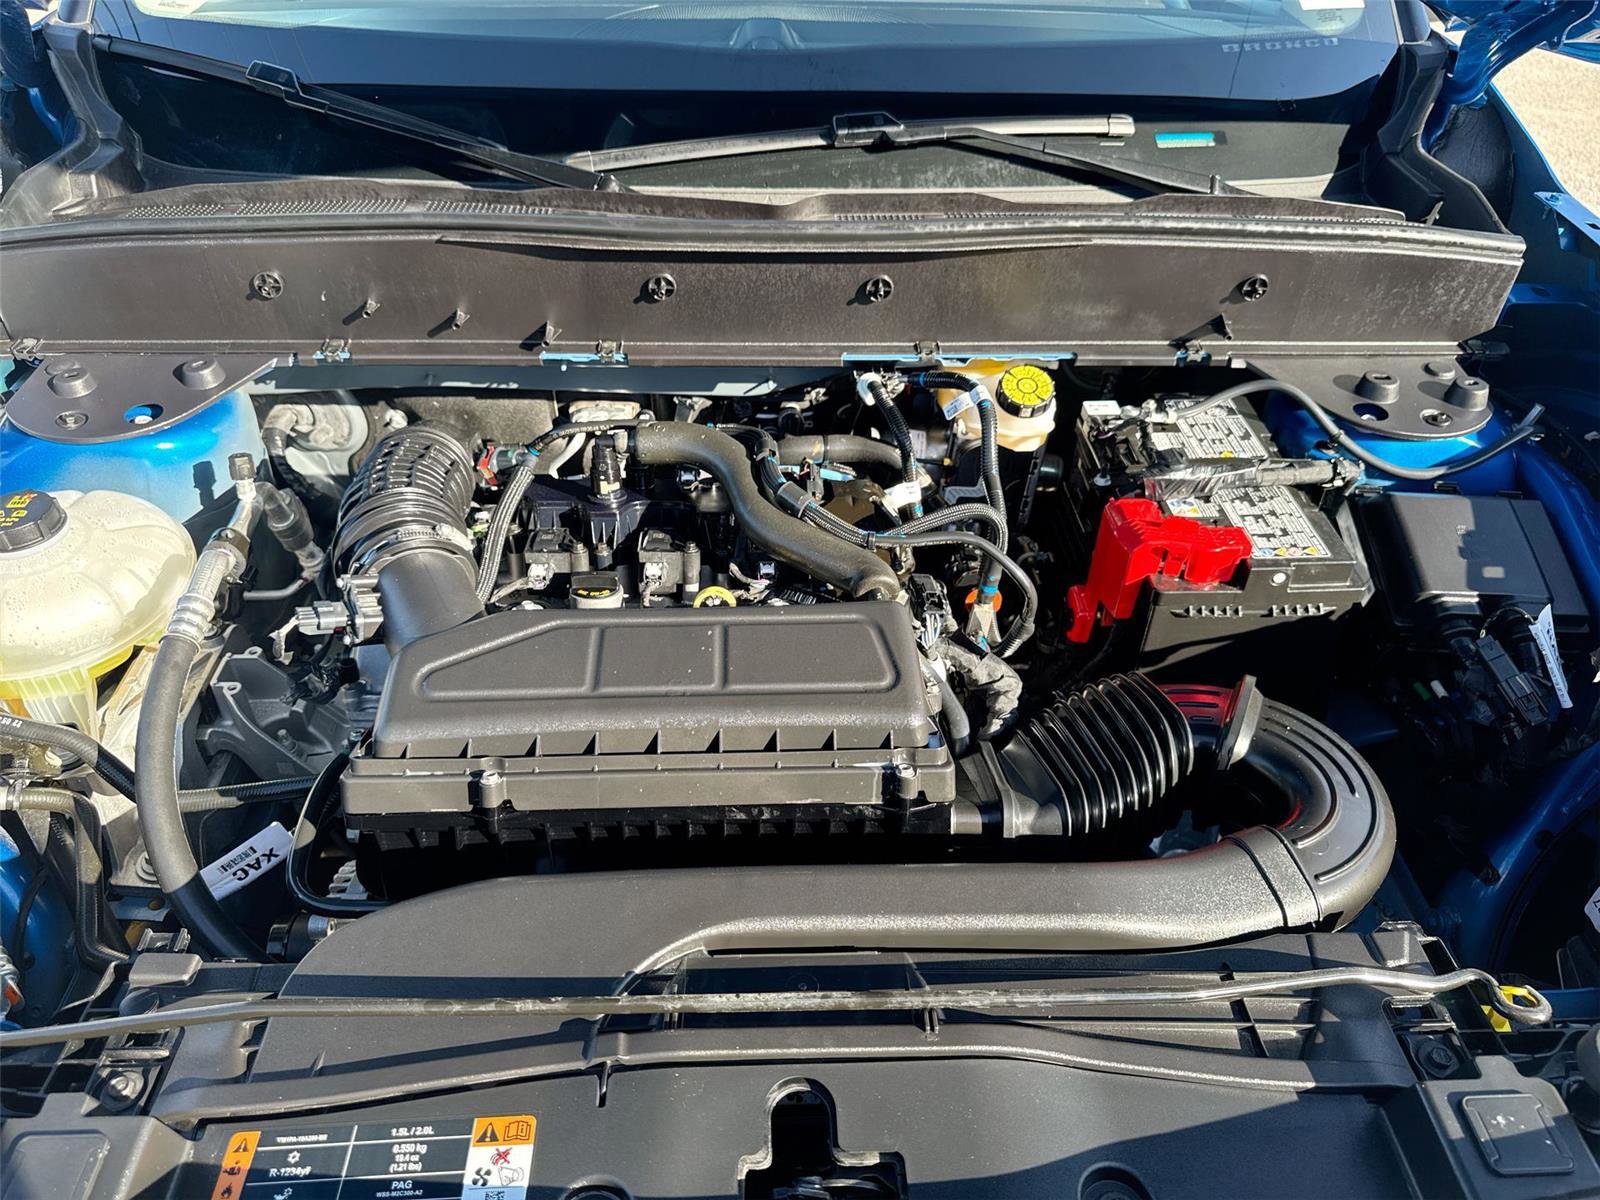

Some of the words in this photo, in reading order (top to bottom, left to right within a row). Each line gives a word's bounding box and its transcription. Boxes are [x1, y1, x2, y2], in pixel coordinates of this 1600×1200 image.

[1221, 37, 1339, 52] BRONCO
[232, 847, 280, 881] XAC
[416, 1142, 428, 1155] kg
[391, 1180, 412, 1189] PAG
